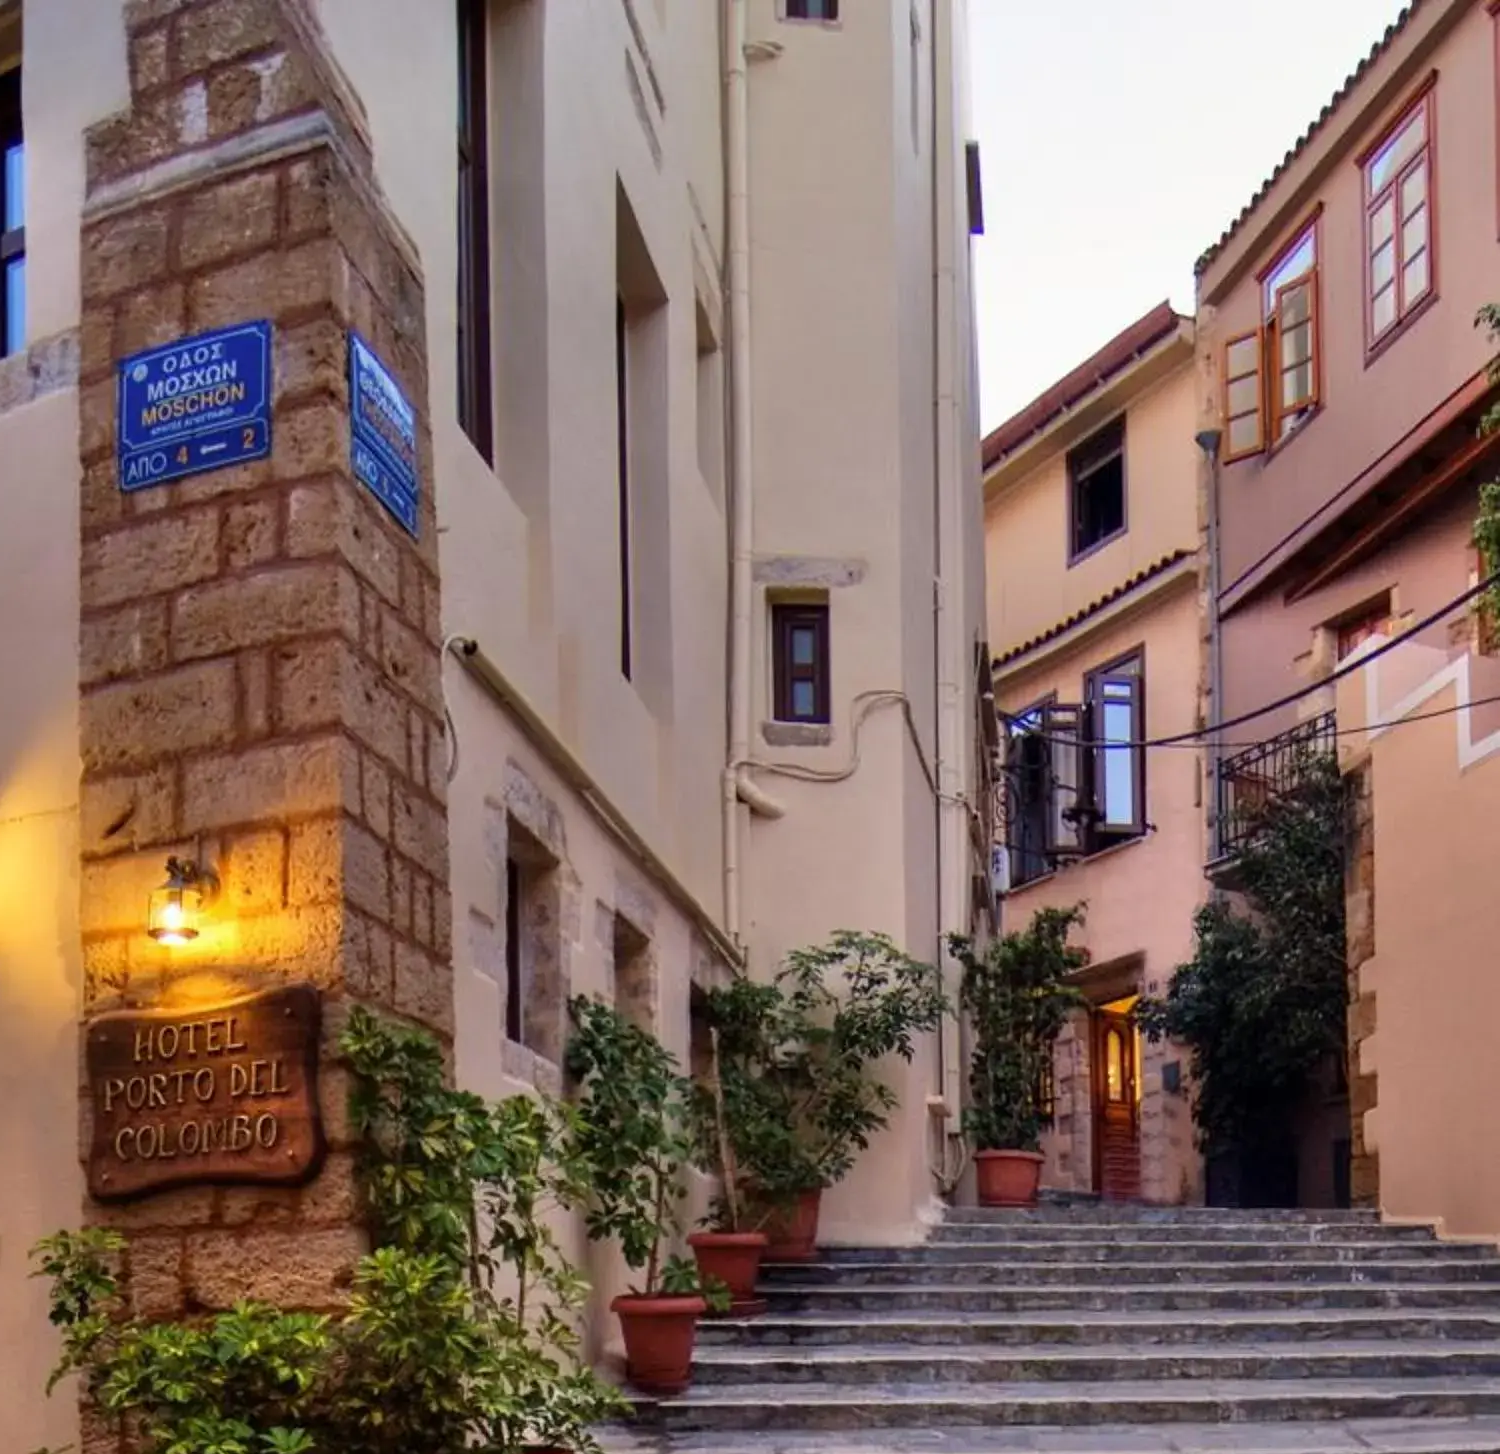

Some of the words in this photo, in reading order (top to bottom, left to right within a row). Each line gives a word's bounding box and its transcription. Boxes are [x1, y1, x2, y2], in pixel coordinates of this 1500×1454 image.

[147, 360, 237, 402] ΜΟΣΧΩΝ
[163, 343, 224, 373] ΟΔΟΣ
[141, 381, 245, 426] MOSCHON
[127, 451, 167, 482] ΑΠΟ
[176, 446, 188, 465] 4
[243, 428, 255, 449] 2
[133, 1016, 246, 1062] HOTEL
[103, 1066, 216, 1112] PORTO
[230, 1059, 289, 1098] DEL
[114, 1112, 278, 1161] COLOMBO
